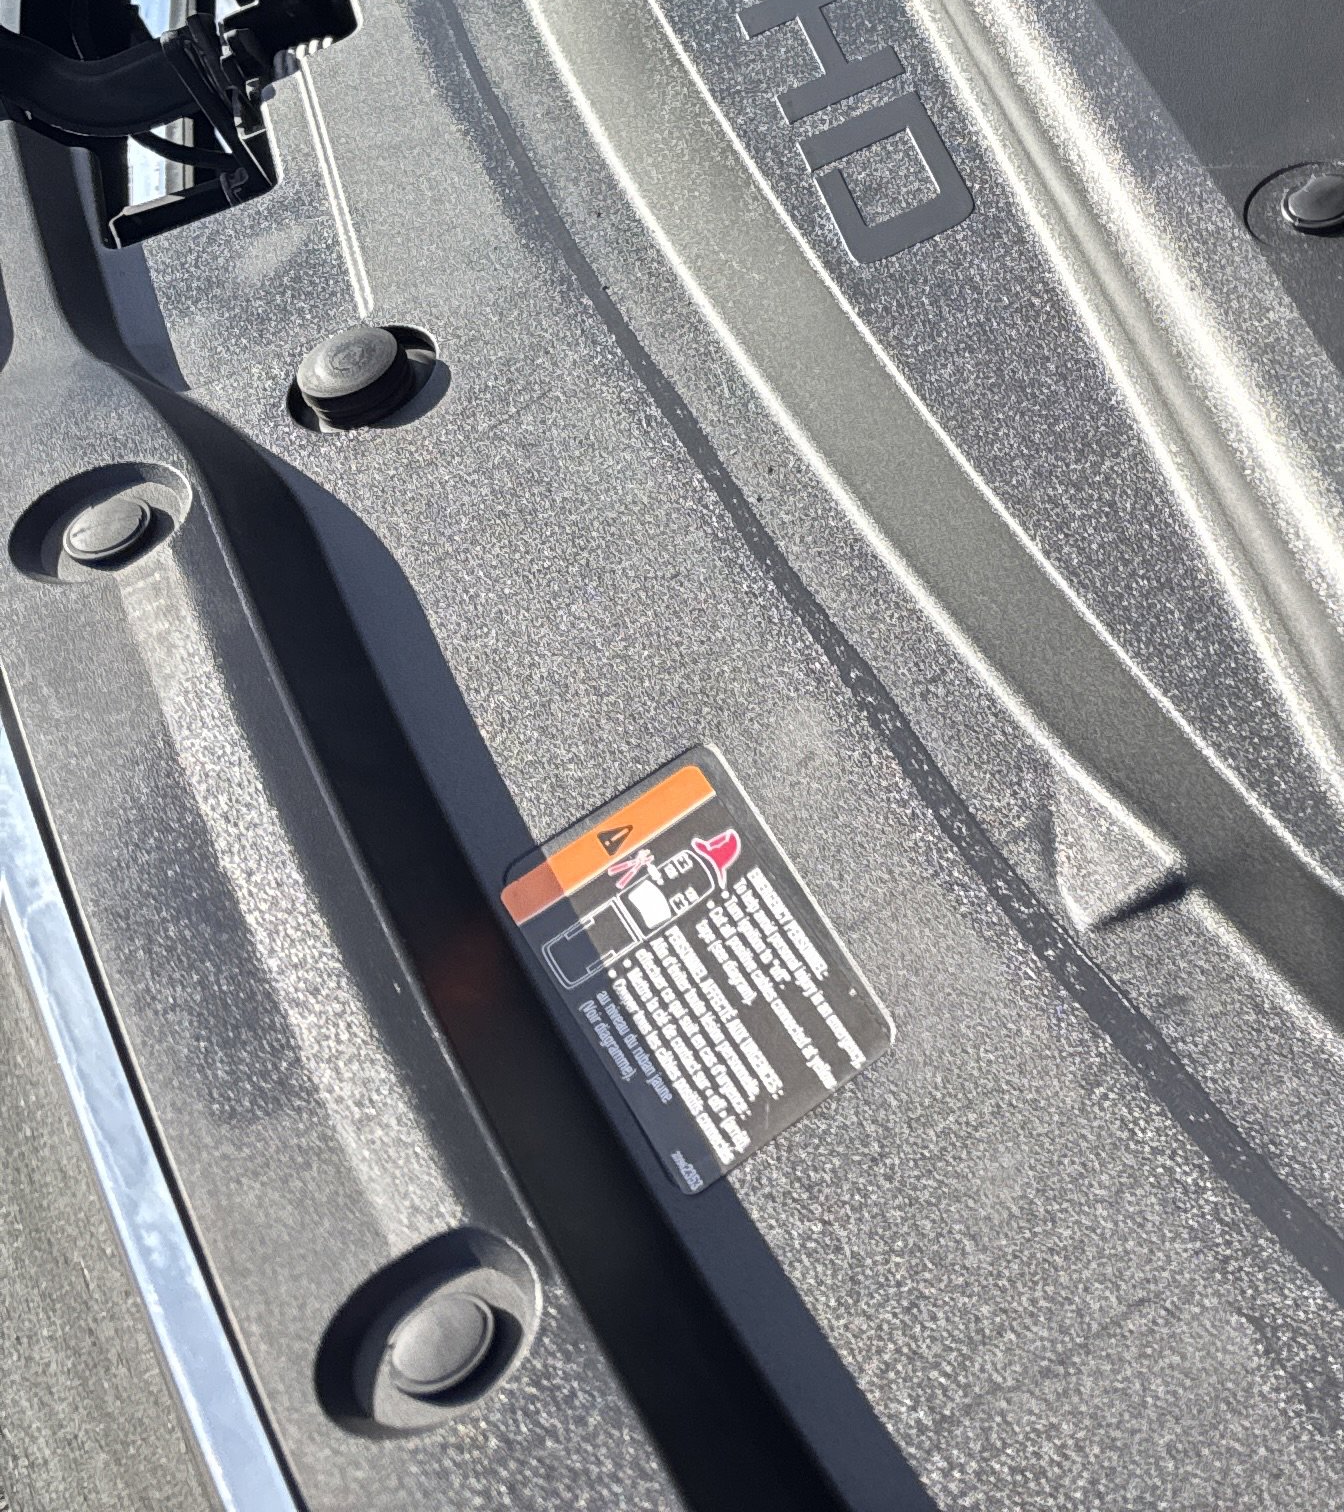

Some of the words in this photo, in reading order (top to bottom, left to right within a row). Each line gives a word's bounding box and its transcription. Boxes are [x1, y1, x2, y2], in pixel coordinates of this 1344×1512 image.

[709, 907, 728, 927] Cut
[696, 919, 716, 943] tape
[719, 924, 736, 939] all
[724, 895, 744, 921] Turn
[737, 917, 766, 953] ignition
[760, 949, 773, 964] to
[734, 878, 747, 894] To
[741, 890, 760, 913] help
[754, 910, 778, 936] avoid
[768, 933, 802, 971] personal
[794, 966, 817, 997] injury
[726, 936, 757, 972] positive
[751, 970, 777, 1002] cables
[579, 1000, 601, 1023] (Voir
[662, 1024, 677, 1040] de
[596, 991, 611, 1005] au
[605, 1003, 629, 1035] niveau
[624, 1034, 638, 1049] du
[633, 1047, 655, 1076] ruban
[646, 1072, 672, 1103] jaune
[699, 1047, 717, 1067] cas
